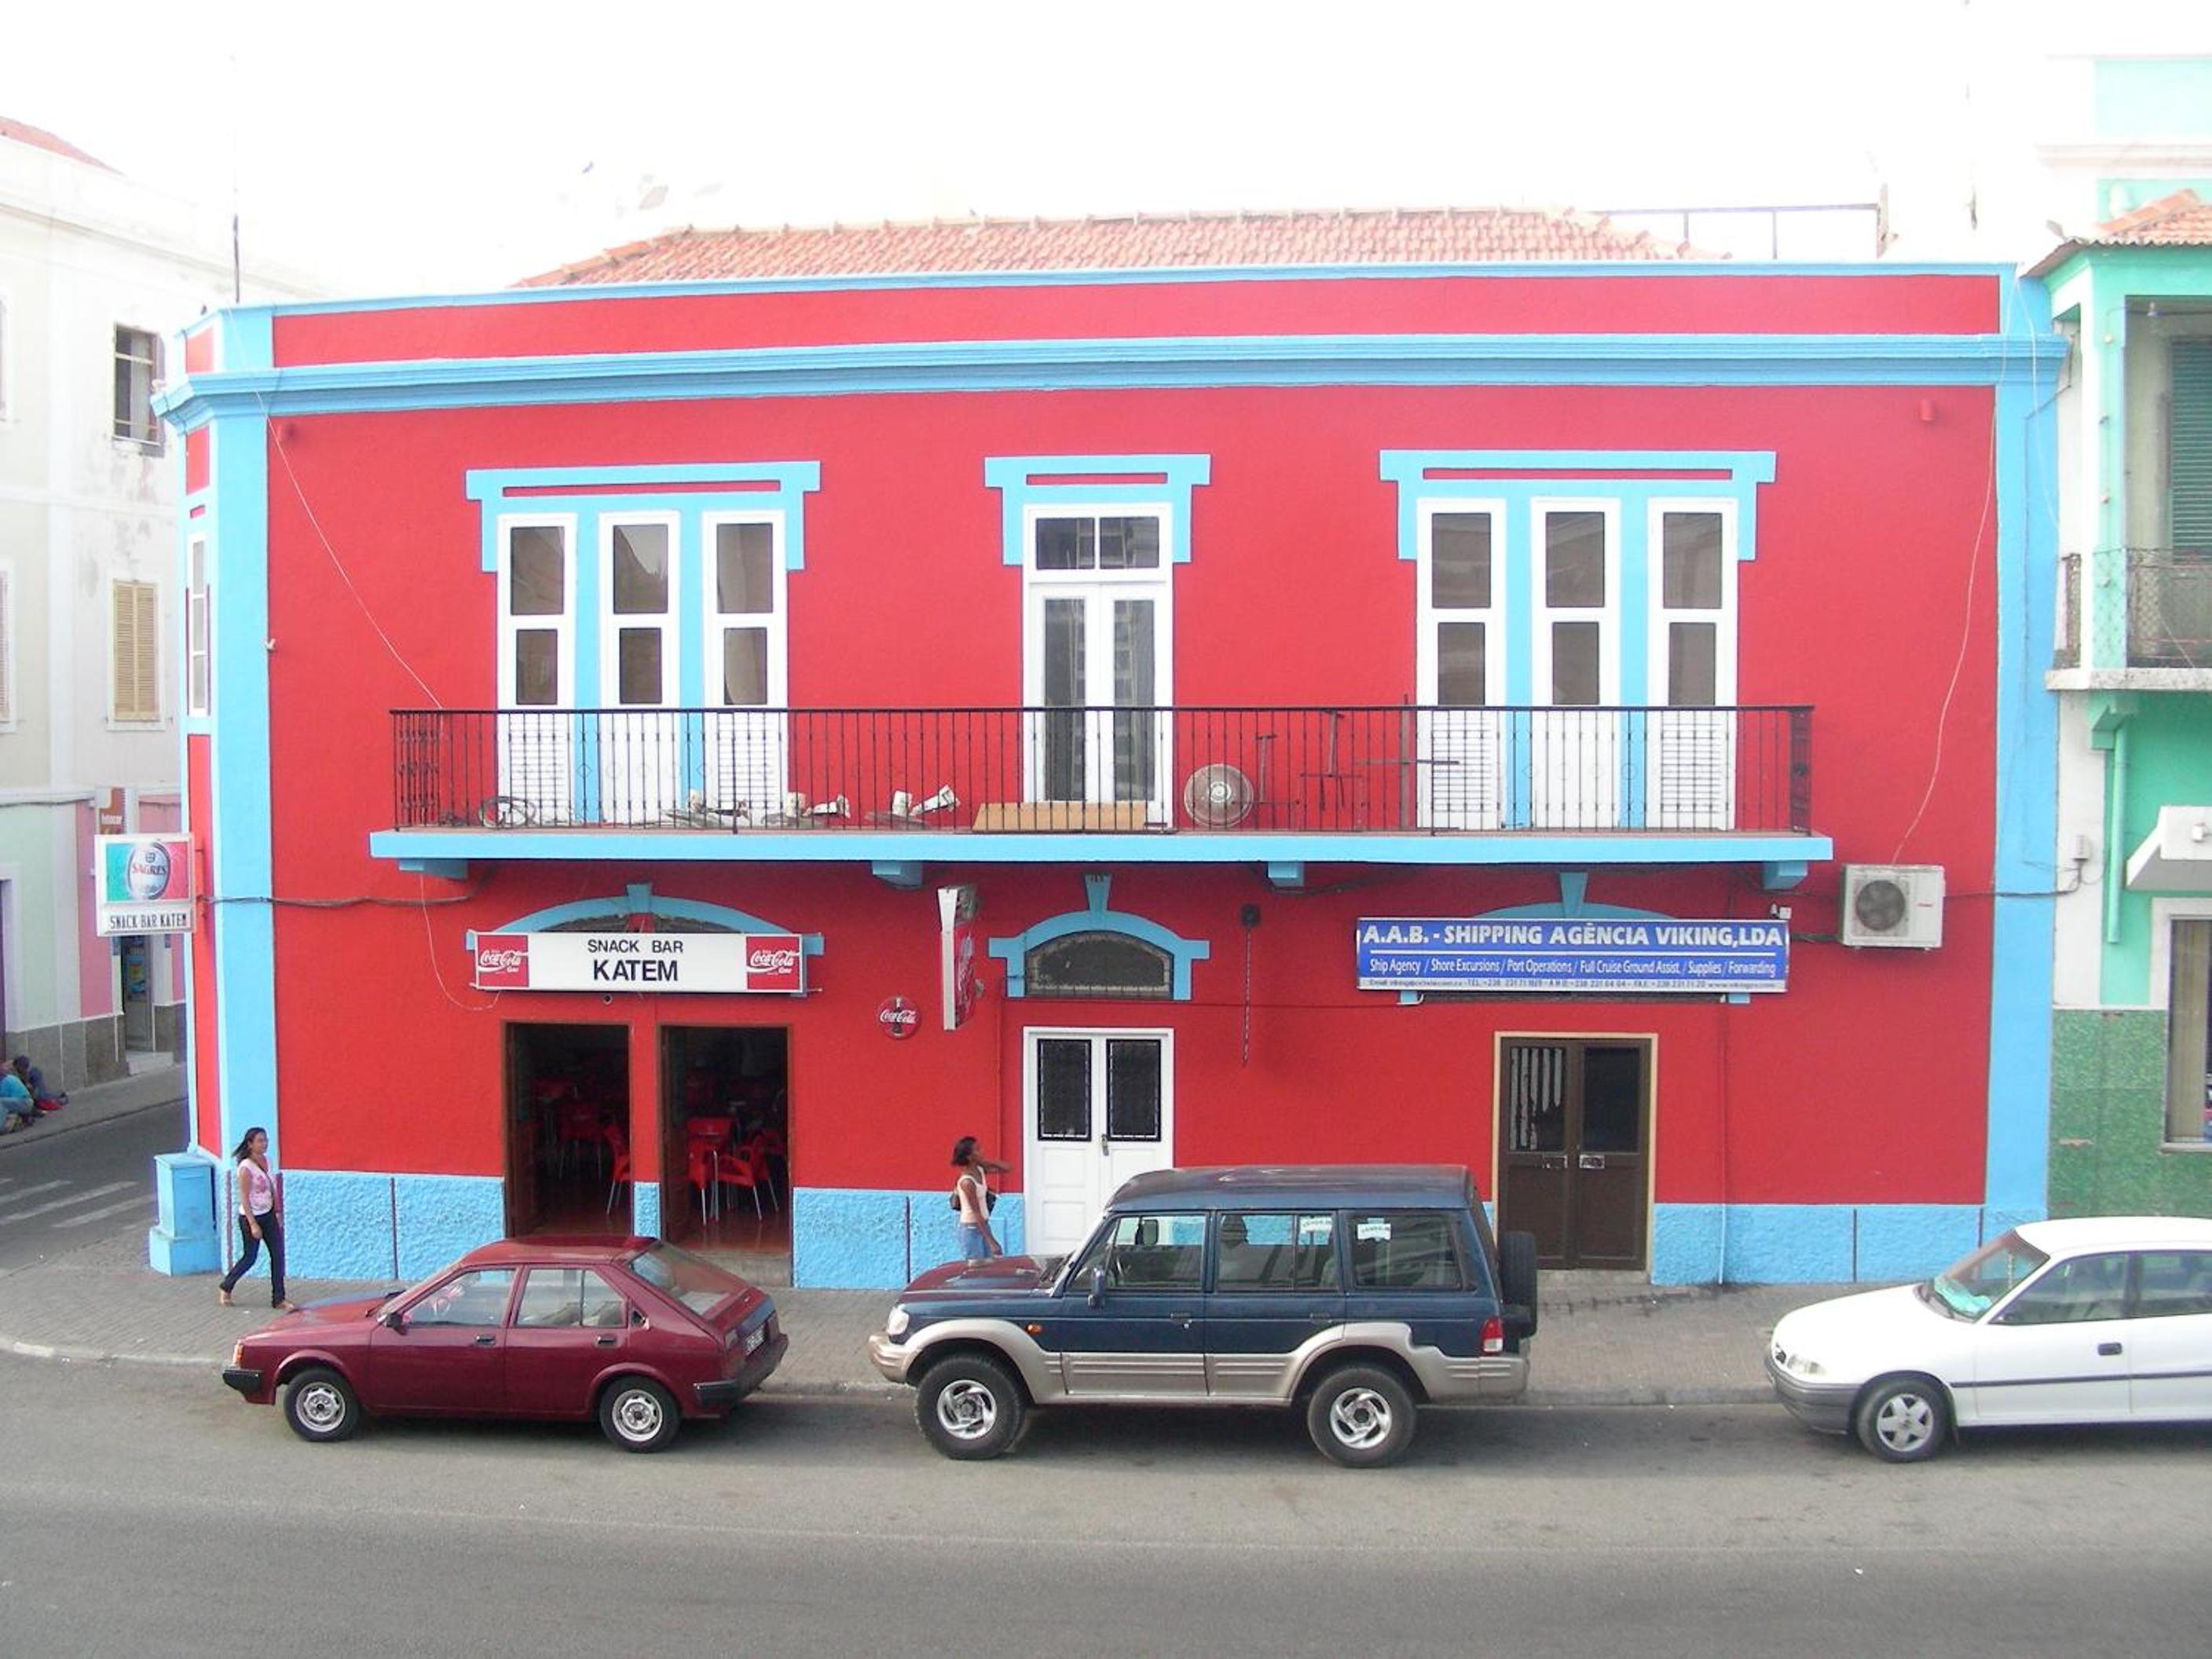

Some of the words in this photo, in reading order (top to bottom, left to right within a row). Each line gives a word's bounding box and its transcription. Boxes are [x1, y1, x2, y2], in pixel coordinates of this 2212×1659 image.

[132, 864, 166, 875] SAGRES
[110, 915, 137, 928] SNACK
[141, 914, 157, 928] BAR
[160, 913, 187, 926] KATEM
[1363, 925, 1429, 944] A.A.B.
[1444, 925, 1542, 945] SHIPPING
[1549, 922, 1649, 946] AGÊNCIA
[588, 939, 639, 953] SNACK
[651, 940, 683, 954] BAR
[593, 959, 678, 981] KATEM
[1370, 958, 1388, 975] Ship
[1389, 960, 1421, 976] Agency
[1431, 958, 1454, 972] Shore
[1456, 959, 1500, 973] Excursions
[1507, 959, 1525, 973] Port
[1525, 959, 1571, 976] Operations
[1580, 960, 1595, 973] Full
[1596, 960, 1622, 974] Cruise
[1623, 960, 1654, 974] Ground
[1688, 960, 1722, 978] Supplies
[1729, 961, 1776, 979] Forwarding
[880, 1009, 917, 1024] Coca-Cola
